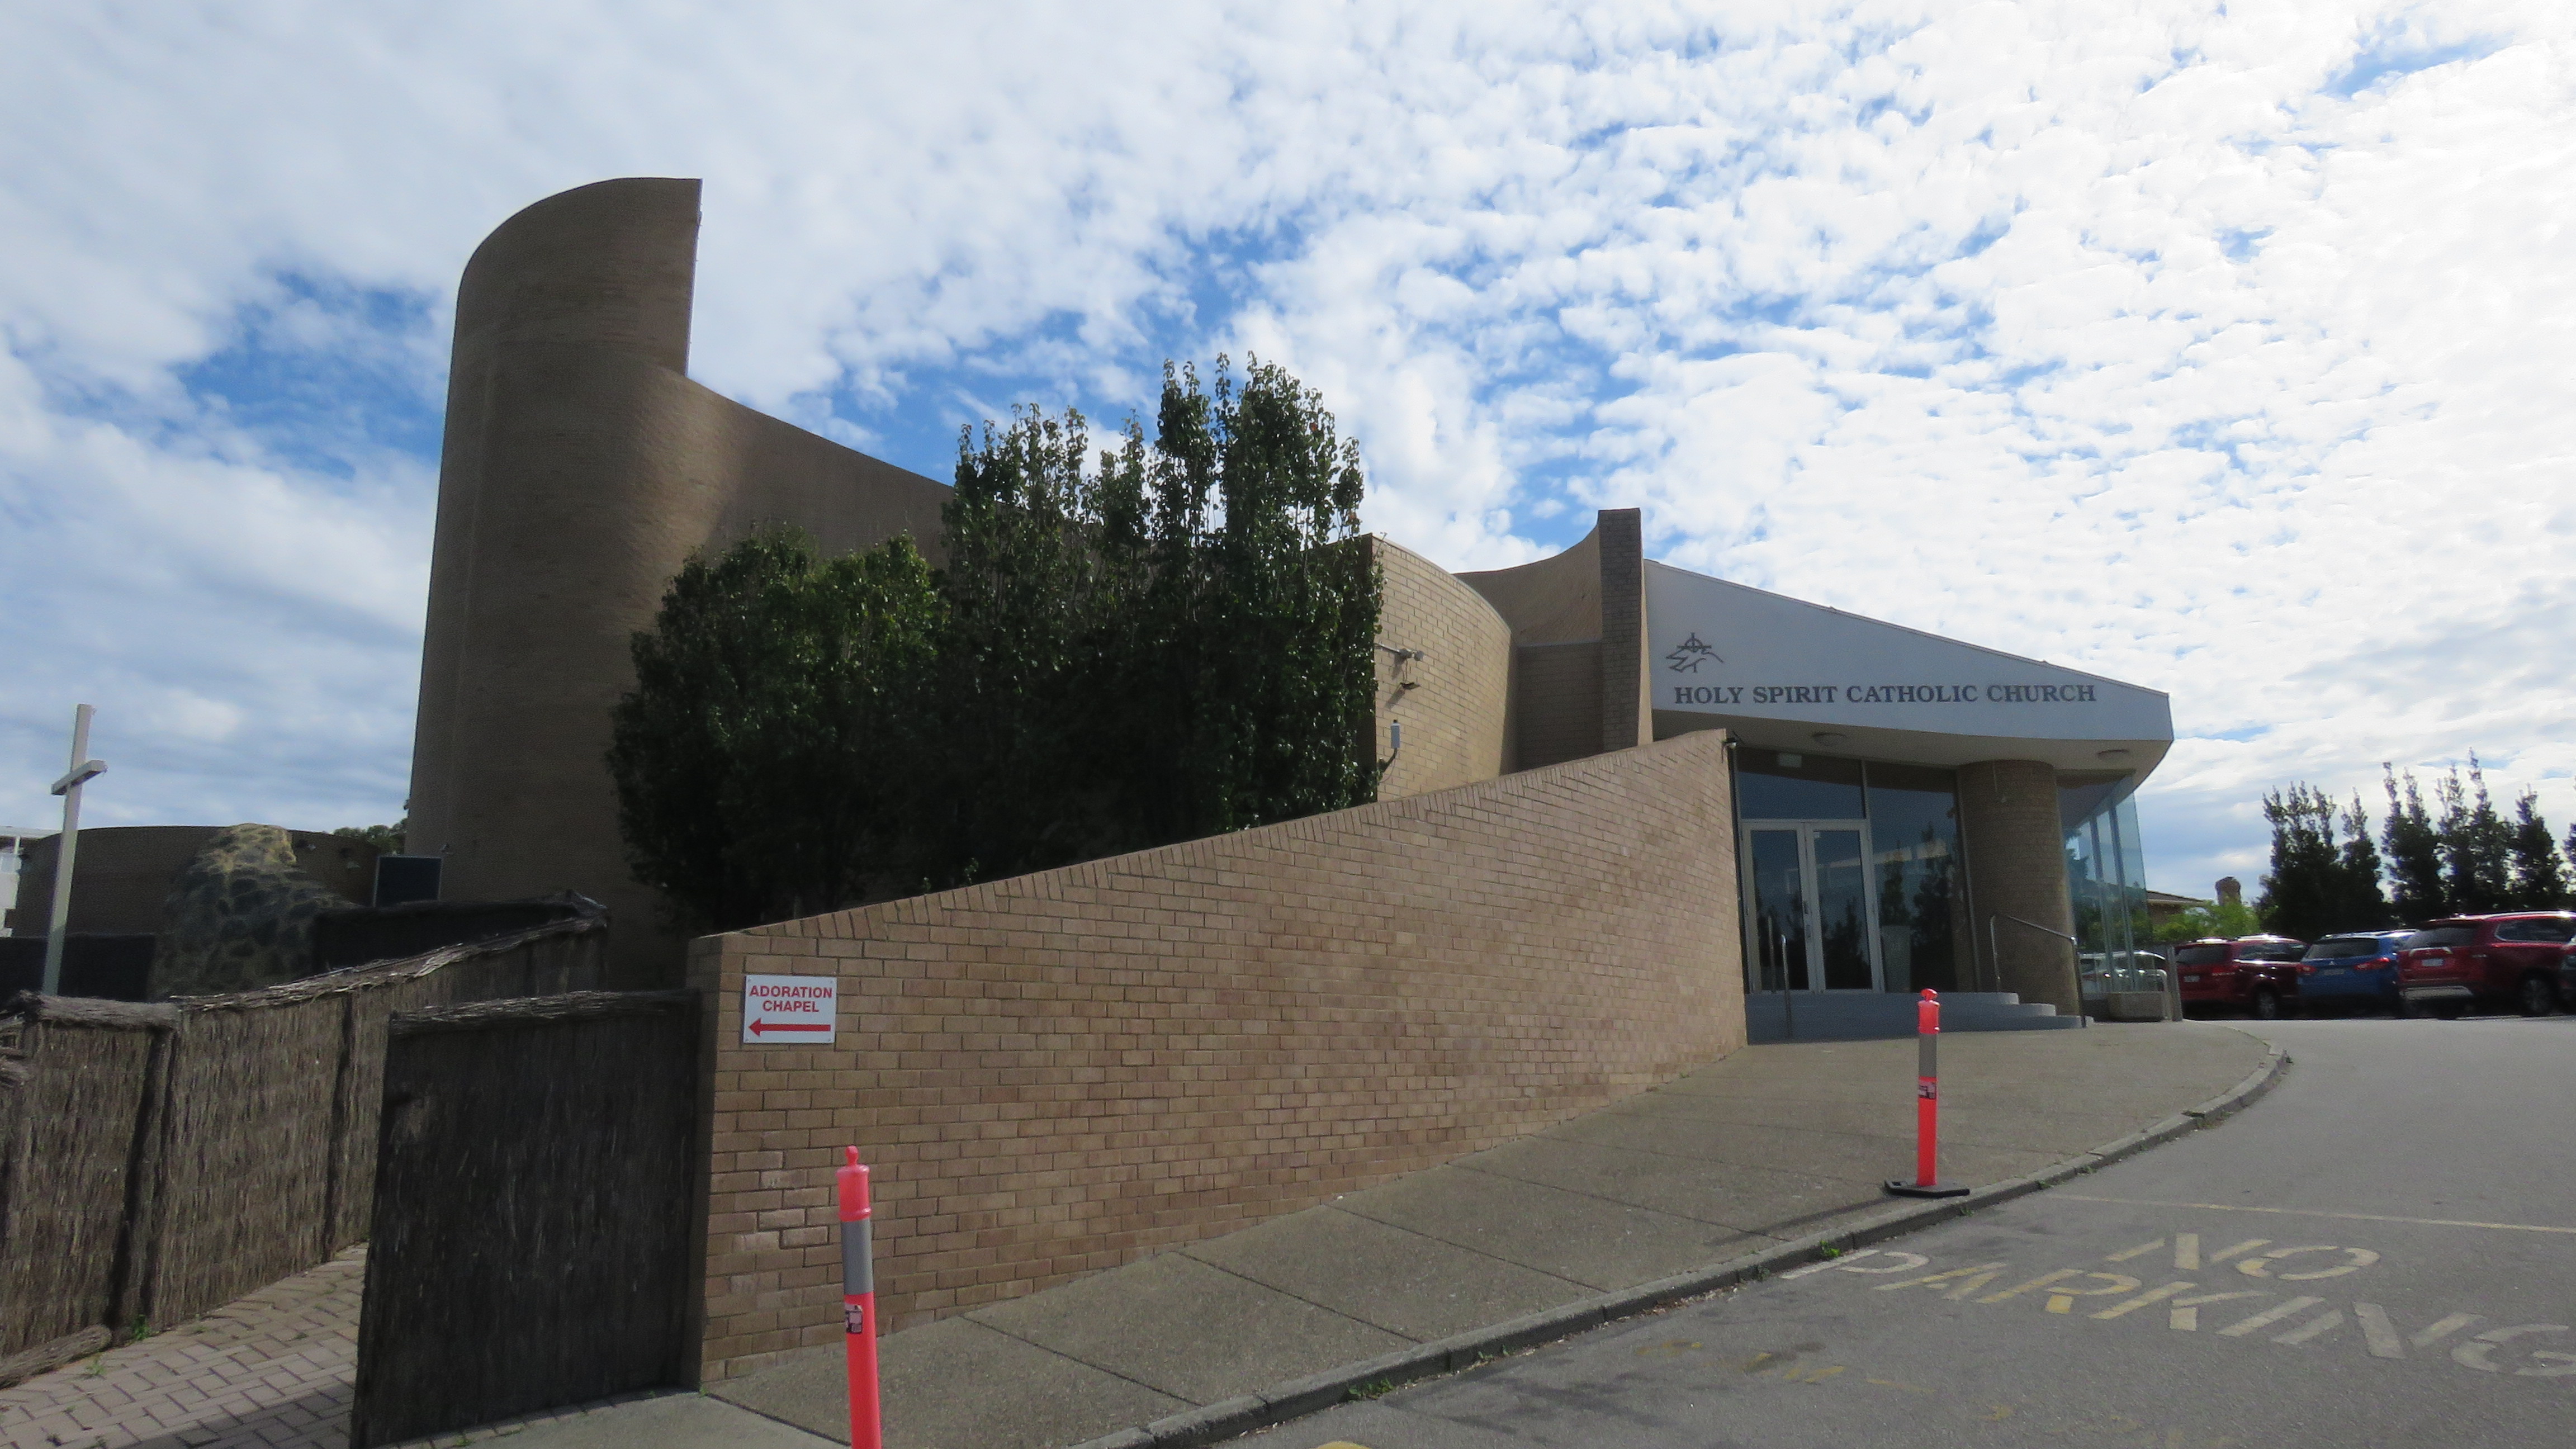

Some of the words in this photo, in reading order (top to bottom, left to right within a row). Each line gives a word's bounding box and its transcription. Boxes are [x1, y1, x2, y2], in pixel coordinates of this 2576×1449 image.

[1674, 686, 1743, 704] HOLY
[1753, 686, 1838, 703] SPIRIT
[1846, 685, 1977, 703] CATHOLIC
[1987, 685, 2096, 702] CHURCH
[749, 986, 832, 998] ADORATION
[763, 1000, 820, 1012] CHAPEL
[2104, 1233, 2380, 1281] NO
[1779, 1249, 2576, 1377] PARKING
